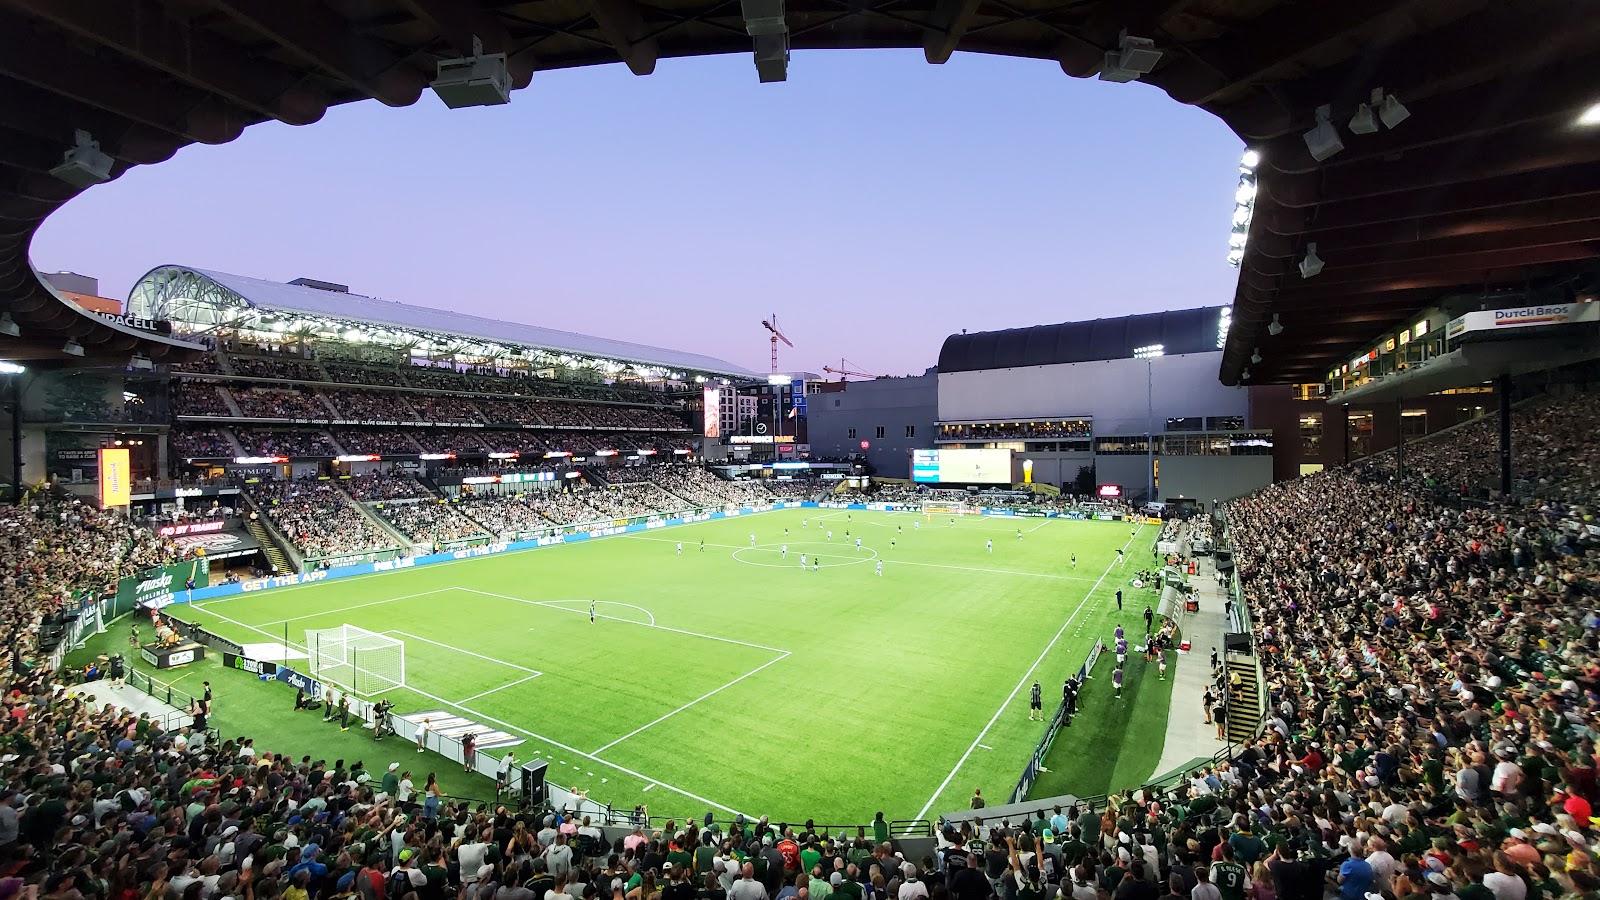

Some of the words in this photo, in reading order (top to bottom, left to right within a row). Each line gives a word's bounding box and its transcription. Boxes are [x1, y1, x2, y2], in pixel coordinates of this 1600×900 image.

[175, 487, 203, 497] Modelo
[574, 520, 613, 532] PROVIDENCE
[613, 518, 629, 527] PARK
[589, 530, 602, 538] GET
[603, 528, 615, 536] THE
[615, 526, 627, 534] APP
[453, 549, 472, 559] GET
[473, 546, 489, 556] THE
[490, 543, 508, 553] APP
[330, 554, 364, 564] ORTLAND
[136, 572, 173, 595] Alaska
[241, 578, 269, 592] GET
[273, 573, 299, 586] THE
[302, 570, 327, 583] APP
[1226, 872, 1237, 888] 9
